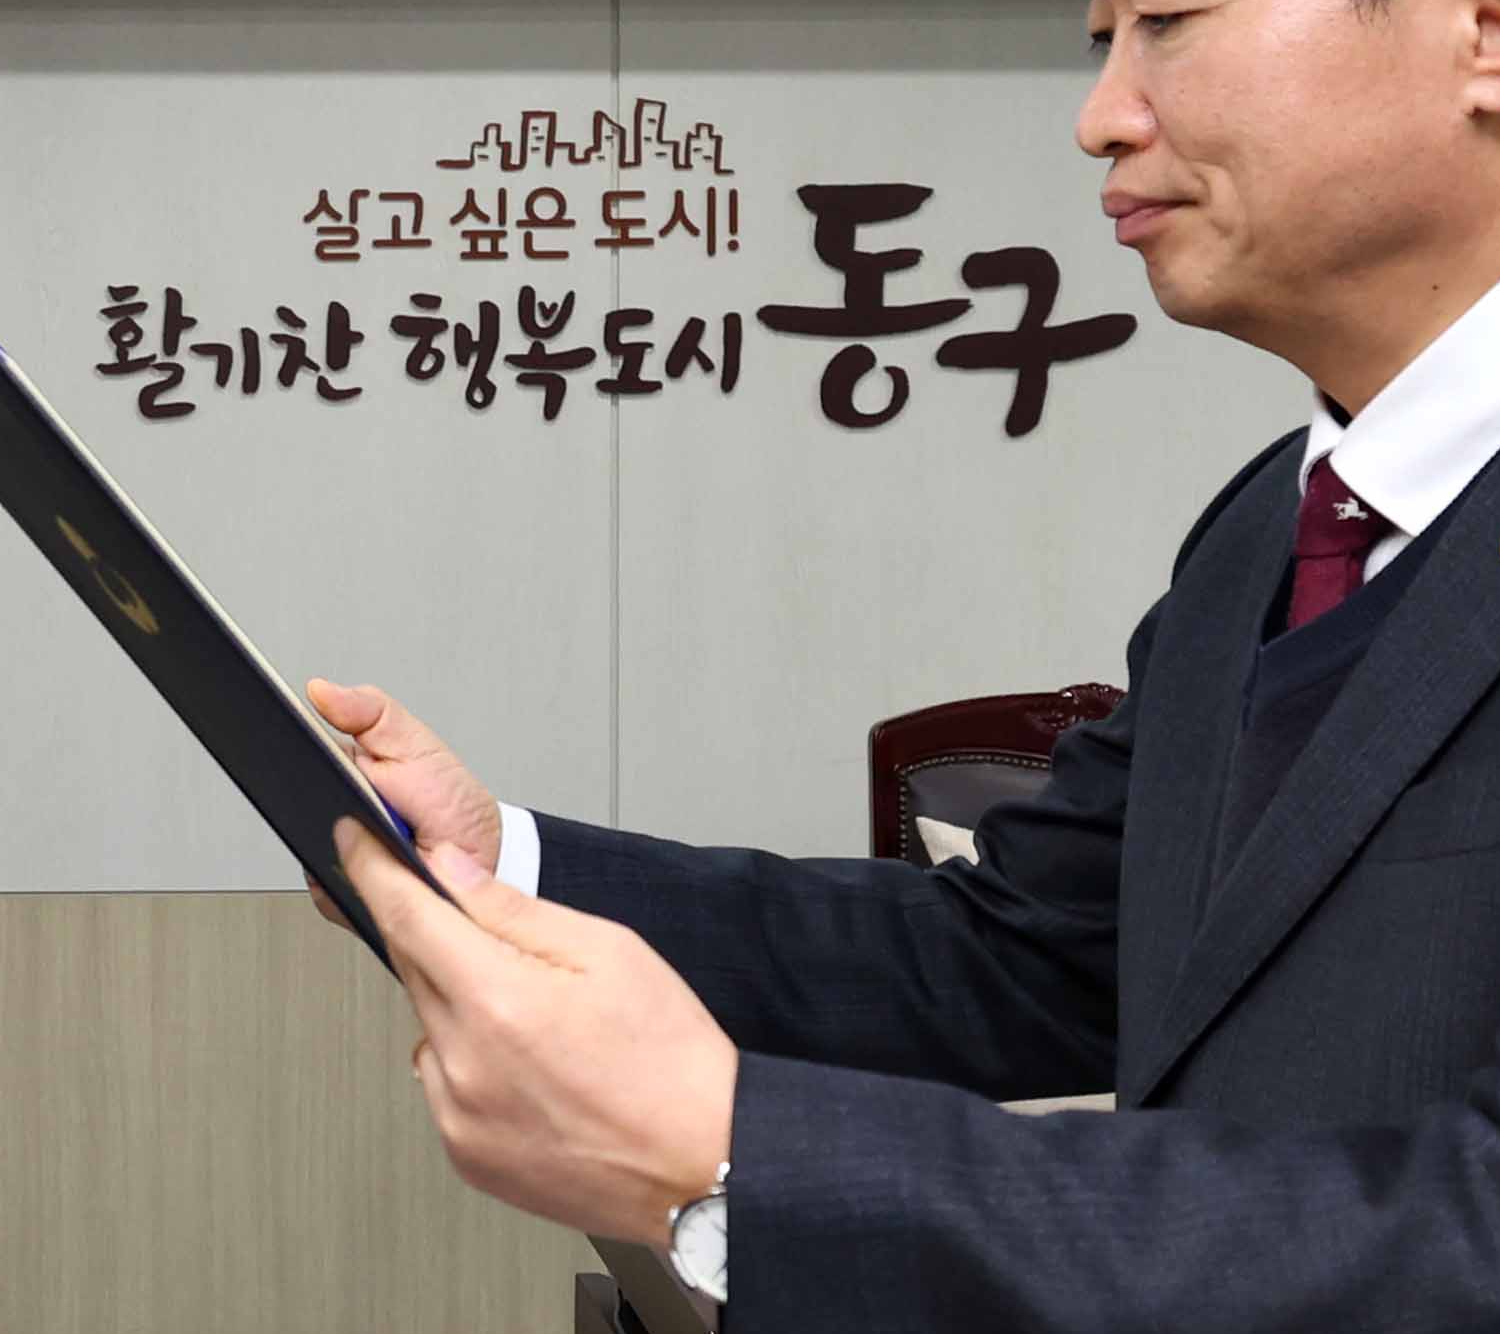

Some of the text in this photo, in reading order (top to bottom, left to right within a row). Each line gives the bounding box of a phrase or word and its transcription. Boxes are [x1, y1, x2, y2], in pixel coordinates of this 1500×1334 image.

[304, 187, 740, 263] 살고 싶은 도시!
[96, 183, 1140, 439] 활기찬 행복도시 동구
